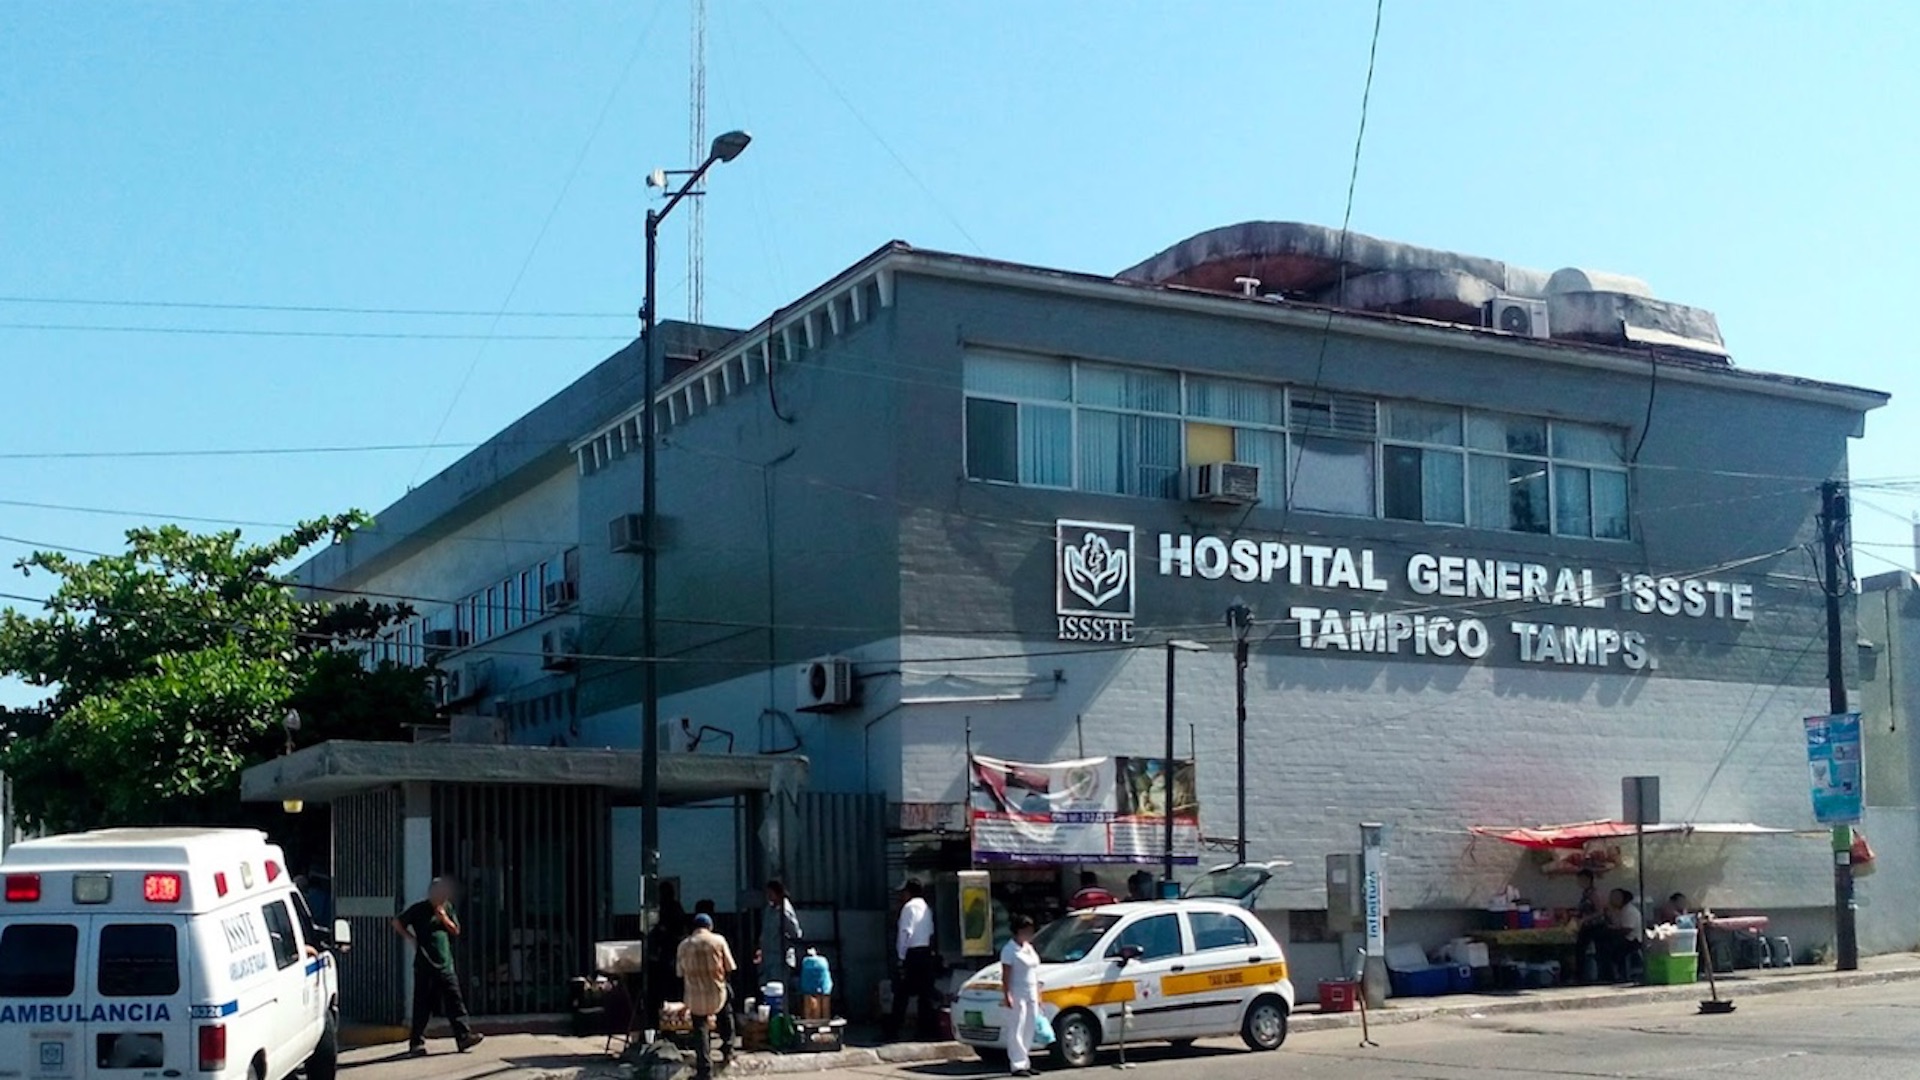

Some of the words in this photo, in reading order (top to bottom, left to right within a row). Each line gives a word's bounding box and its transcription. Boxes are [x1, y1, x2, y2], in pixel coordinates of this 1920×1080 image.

[1159, 533, 1388, 592] HOSPITAL
[1408, 554, 1605, 608] GENERAL
[1619, 572, 1754, 621] ISSSTE
[1058, 617, 1136, 642] ISSSTE
[1290, 607, 1490, 659] TAMPICO
[1511, 621, 1658, 670] TAMPS.
[0, 1003, 171, 1023] AMBULANCIA
